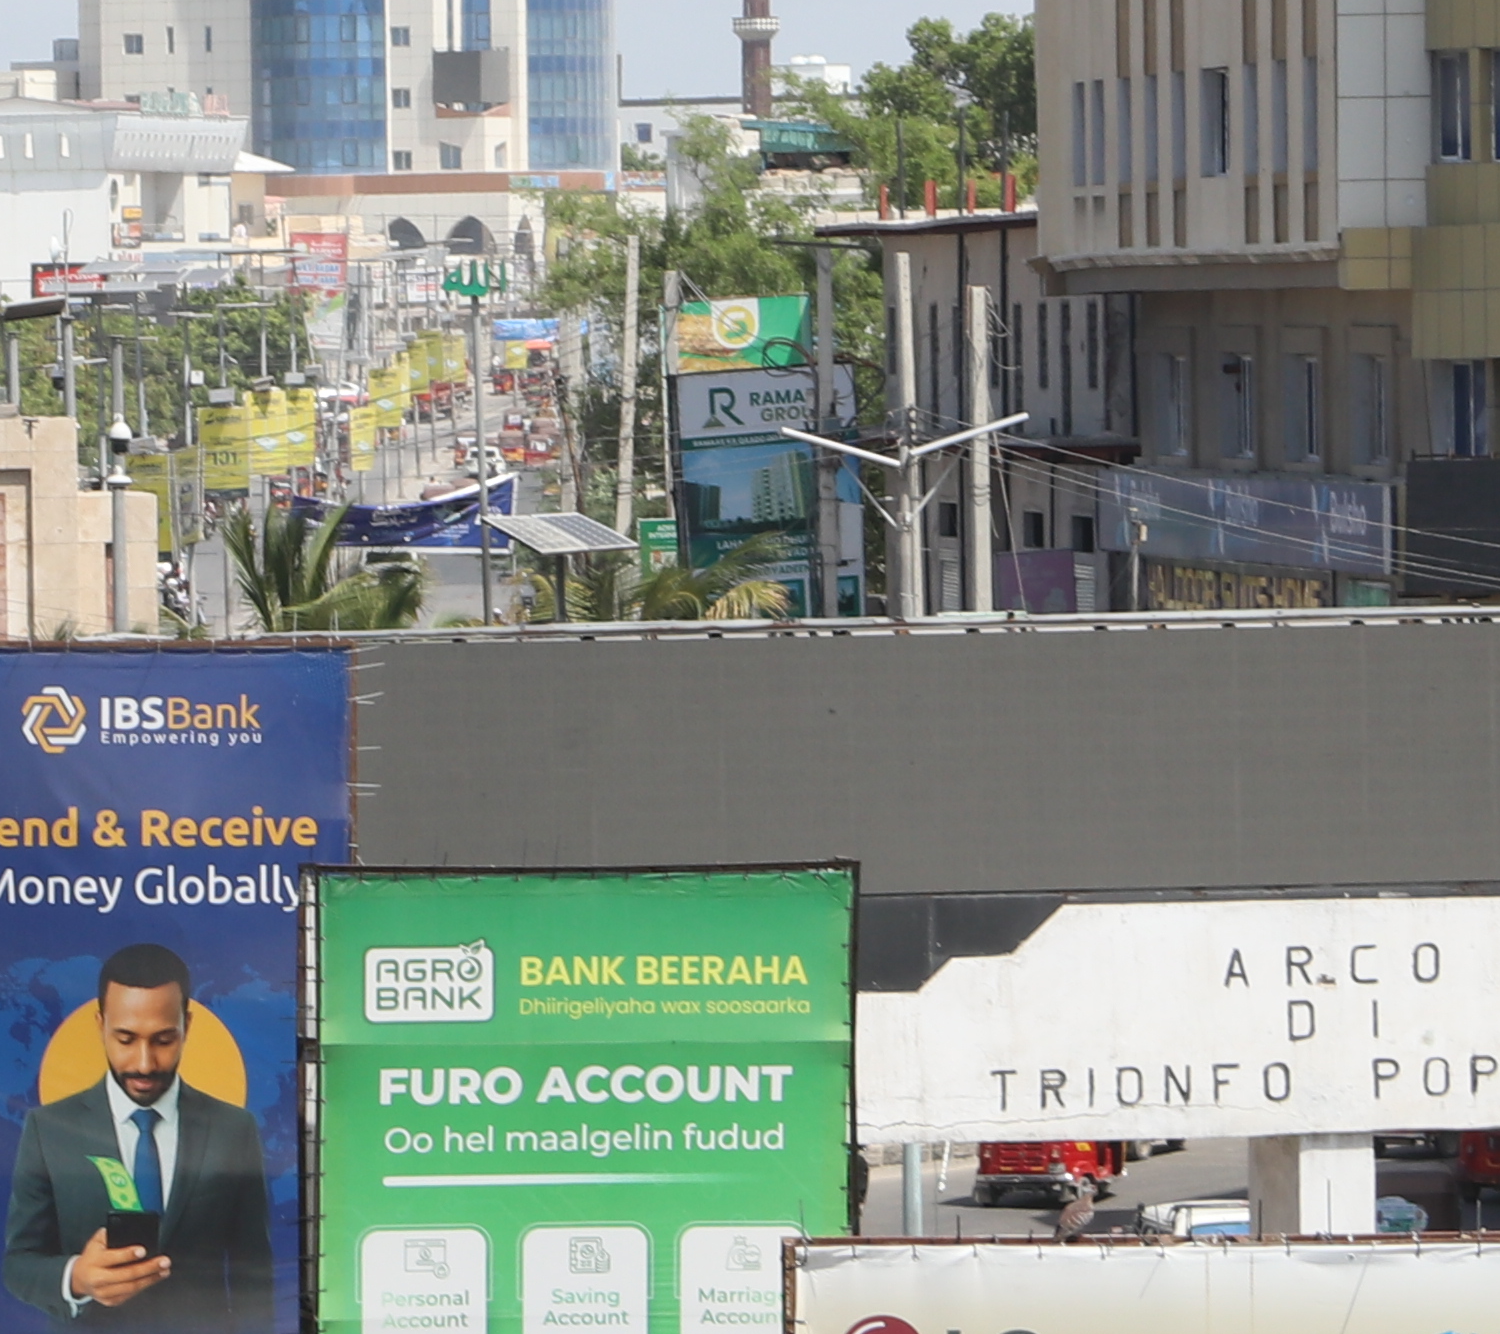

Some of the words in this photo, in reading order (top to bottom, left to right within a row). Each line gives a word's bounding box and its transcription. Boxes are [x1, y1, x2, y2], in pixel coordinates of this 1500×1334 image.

[442, 258, 506, 297] الله
[100, 694, 261, 731] IBSBank
[100, 730, 220, 747] Empowering
[228, 729, 263, 747] you
[92, 809, 128, 848] &
[141, 805, 319, 848] Receive
[133, 863, 300, 913] Globally
[375, 954, 484, 984] AGRO
[519, 955, 626, 987] BANK
[635, 953, 809, 986] BEERAHA
[1224, 942, 1442, 989] ARCO
[375, 987, 483, 1012] BANK
[518, 996, 656, 1020] Dhiirigeliyaha
[661, 999, 700, 1015] wax
[704, 996, 811, 1016] soosaarka
[1287, 998, 1381, 1043] DI
[377, 1066, 524, 1107] FURO
[535, 1064, 793, 1104] ACCOUNT
[989, 1061, 1294, 1113] TRIONFO
[383, 1126, 434, 1154] Oo
[443, 1124, 495, 1154] hel
[505, 1122, 674, 1157] maalgelin
[682, 1122, 785, 1152] fudud
[381, 1289, 471, 1309] Personal
[551, 1287, 621, 1310] Saving
[381, 1312, 470, 1329] Account
[543, 1309, 630, 1327] Account
[699, 1307, 779, 1326] Accoun
